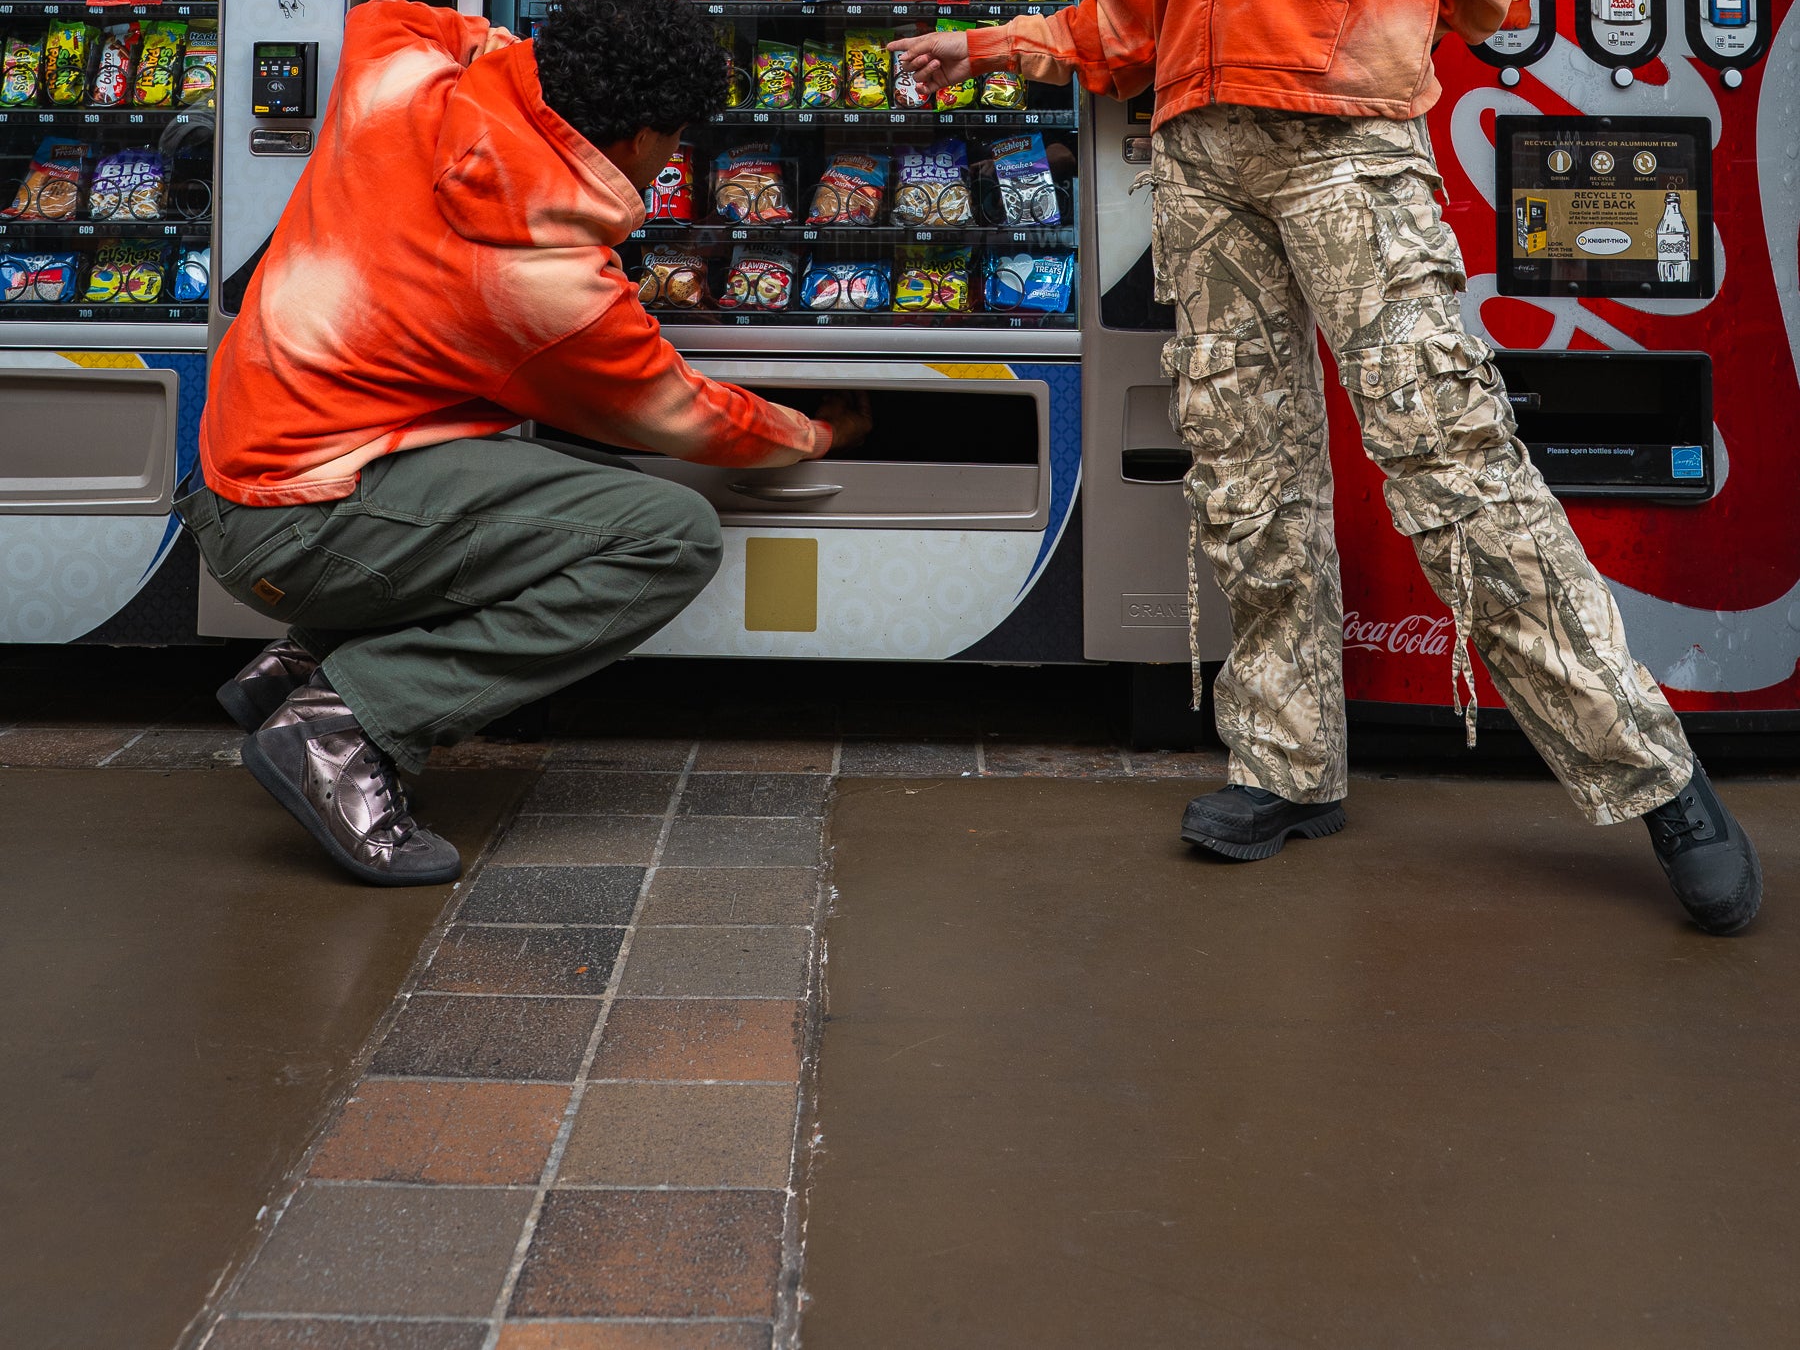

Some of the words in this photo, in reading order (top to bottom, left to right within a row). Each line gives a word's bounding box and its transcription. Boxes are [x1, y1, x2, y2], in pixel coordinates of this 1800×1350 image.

[88, 6, 104, 14] 409
[133, 6, 147, 14] 410
[178, 6, 190, 14] 411
[708, 5, 723, 14] 405
[801, 5, 816, 14] 407
[847, 6, 861, 14] 408
[893, 6, 908, 14] 409
[938, 6, 952, 14] 410
[988, 6, 1001, 14] 411
[1027, 6, 1040, 14] 412
[100, 52, 112, 85] bueno
[141, 47, 160, 87] PATCH
[153, 48, 174, 85] SOUR
[863, 52, 879, 87] SOUR
[39, 114, 54, 122] 508
[85, 114, 100, 122] 509
[130, 115, 143, 123] 510
[177, 115, 189, 123] 511
[754, 114, 769, 122] 506
[798, 114, 813, 122] 507
[844, 114, 859, 122] 508
[890, 114, 905, 123] 509
[940, 115, 953, 123] 510
[985, 115, 998, 123] 511
[1025, 115, 1039, 123] 512
[992, 139, 1030, 156] Freshley's
[904, 153, 953, 167] BIG
[101, 161, 150, 178] BIG
[995, 161, 1034, 172] Cupcakes
[901, 166, 960, 180] TEXAS
[95, 175, 161, 191] TEXAS
[1571, 200, 1599, 209] GIVE
[1603, 200, 1636, 209] BACK
[79, 226, 94, 234] 609
[164, 226, 177, 234] 611
[631, 230, 646, 239] 603
[732, 230, 747, 239] 605
[803, 231, 818, 240] 607
[916, 232, 931, 240] 609
[1013, 232, 1026, 241] 611
[1035, 266, 1062, 275] TREATS
[1031, 289, 1060, 298] Original
[80, 309, 93, 318] 709
[169, 309, 180, 318] 711
[736, 315, 750, 324] 705
[816, 315, 830, 324] 707
[1010, 317, 1022, 326] 711
[1613, 448, 1635, 456] slowly
[1128, 603, 1189, 618] CRANE
[1342, 611, 1453, 655] Coca-Cola
